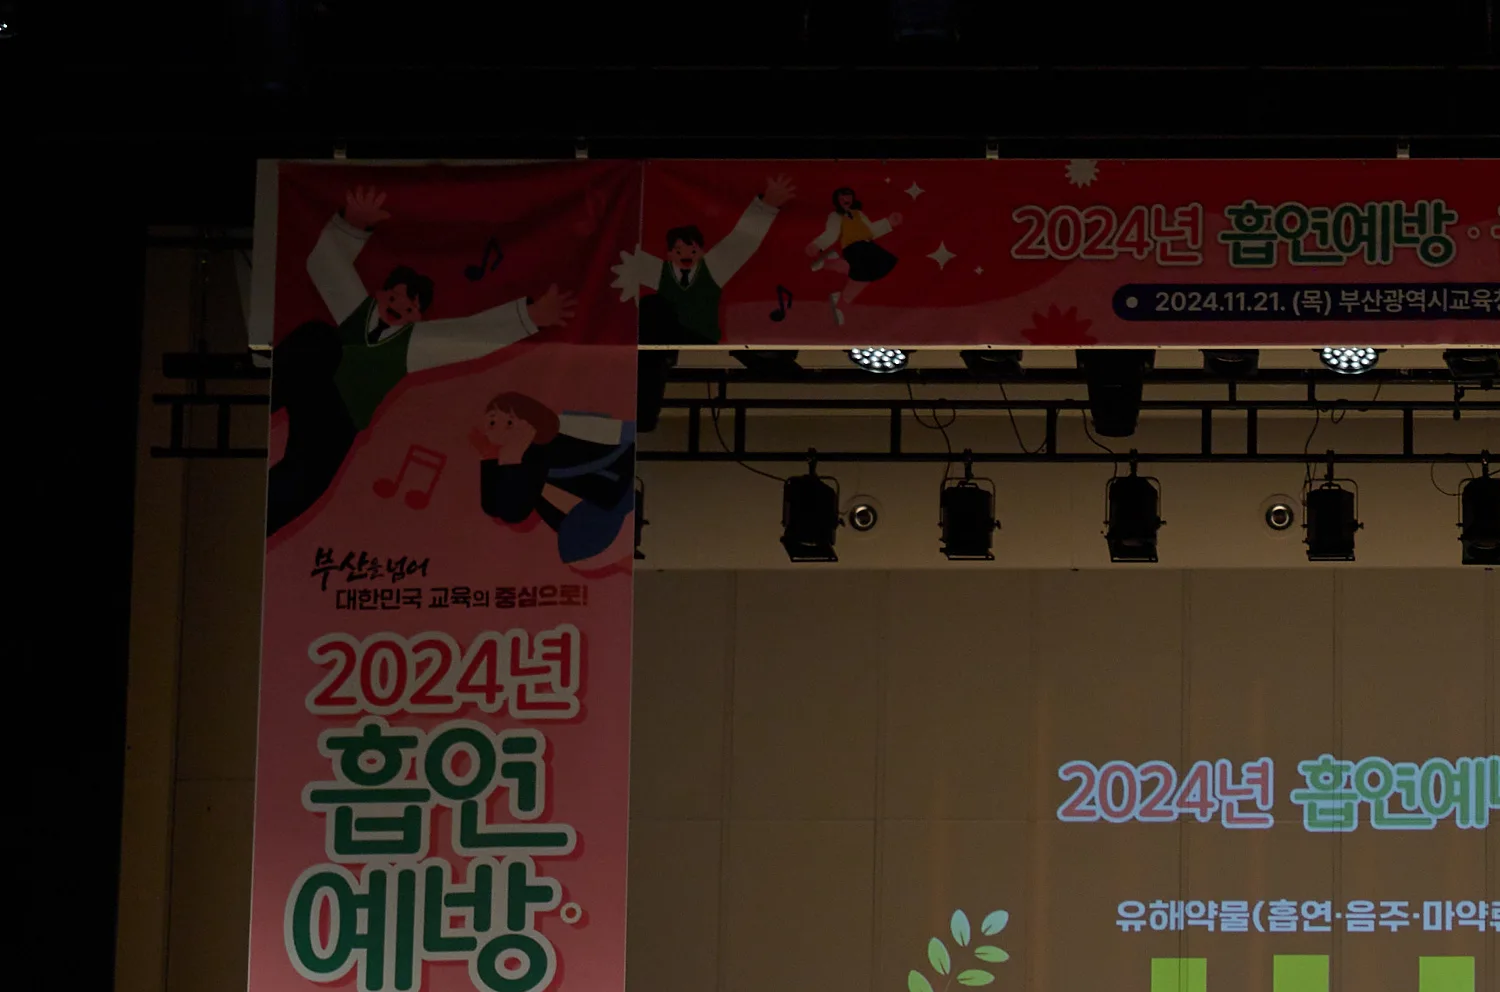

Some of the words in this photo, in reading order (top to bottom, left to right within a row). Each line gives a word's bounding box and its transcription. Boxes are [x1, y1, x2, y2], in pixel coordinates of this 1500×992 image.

[1012, 203, 1201, 266] 2024년
[1219, 199, 1456, 266] 흡연예방
[1154, 288, 1288, 313] 2024.11.21.
[1291, 287, 1333, 317] (목)
[311, 547, 382, 592] 부산을
[385, 557, 430, 583] 넘어
[335, 586, 423, 611] 대한민국
[427, 585, 490, 609] 교육의
[494, 584, 588, 609] 중심으로!
[309, 628, 576, 715] 2024년
[305, 719, 573, 858] 흡연
[1057, 756, 1274, 828] 2024년
